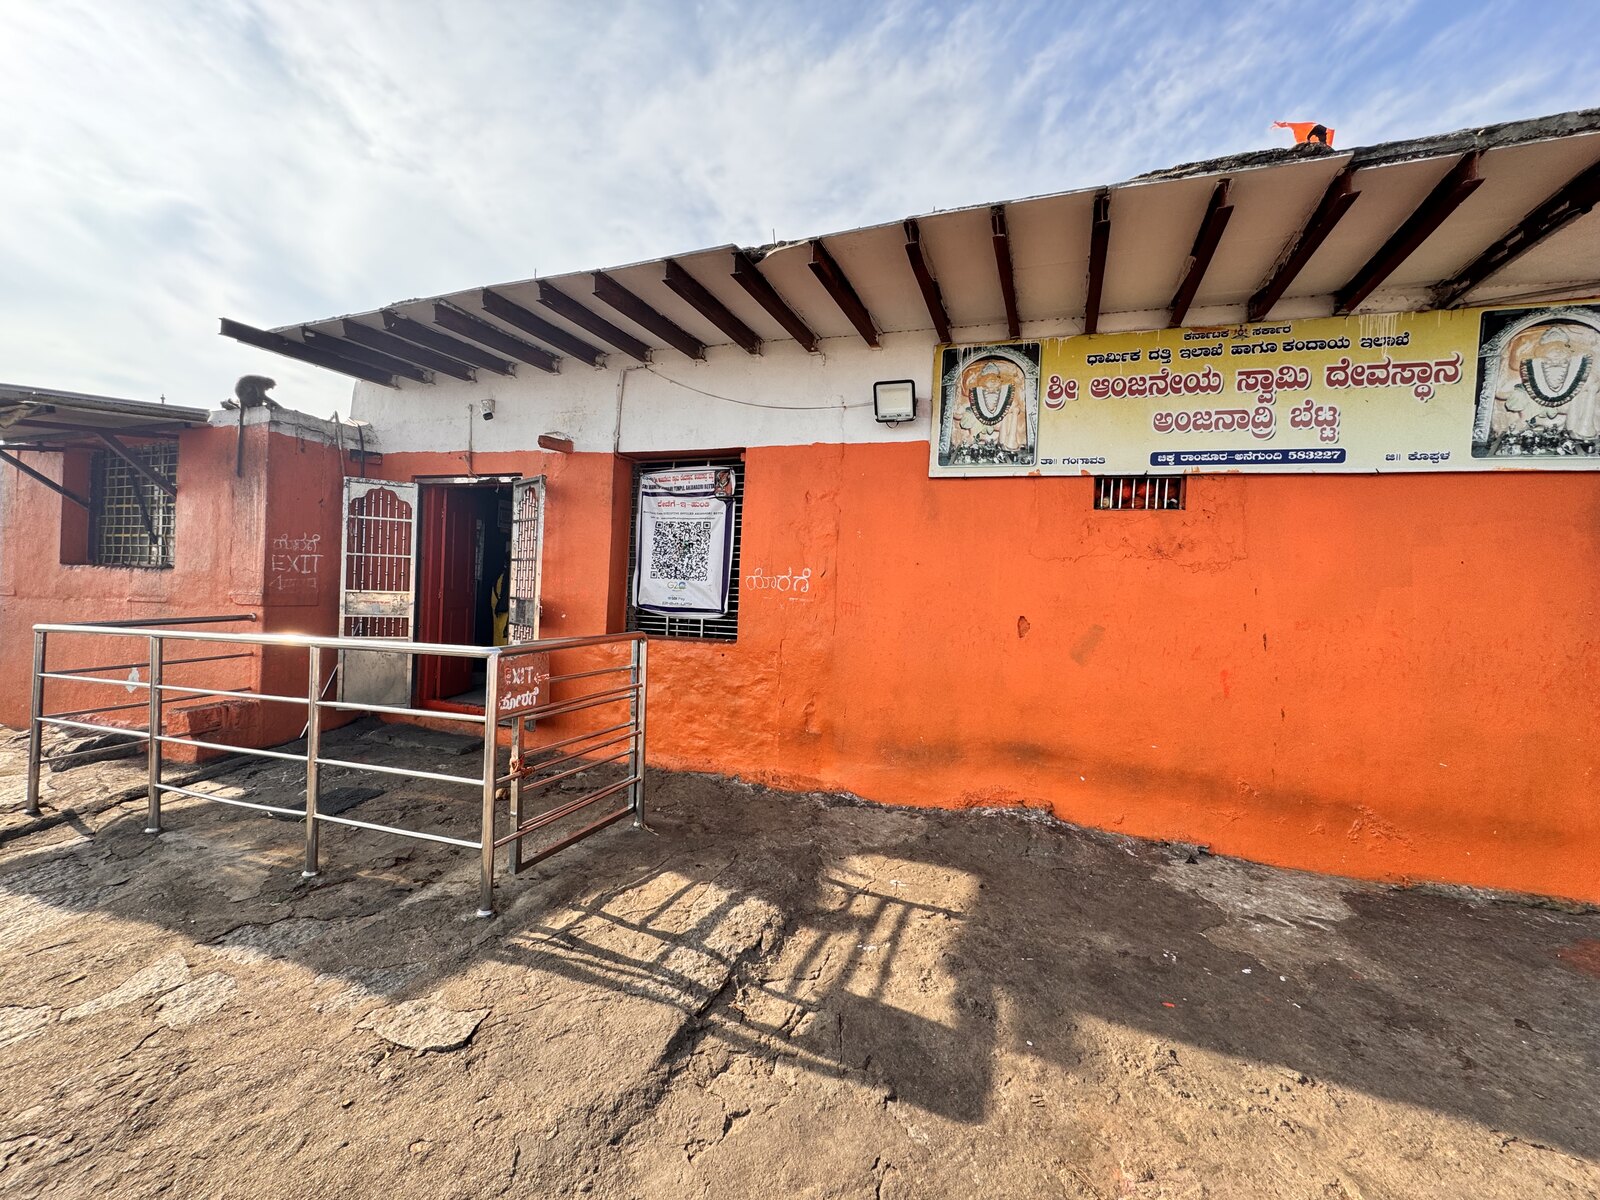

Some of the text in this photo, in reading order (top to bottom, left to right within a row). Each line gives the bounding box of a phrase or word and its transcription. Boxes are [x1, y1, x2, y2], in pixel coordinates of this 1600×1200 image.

[1184, 325, 1292, 341] ಕರ್ನಾಟಕ ಸರ್ಕಾರ
[1087, 349, 1141, 365] ಧಾರ್ಮಿಕ
[1148, 348, 1172, 364] ದತ್ತಿ
[1179, 343, 1224, 360] ಇಲಾಖೆ
[1231, 341, 1277, 355] ಹಾಗೂ
[1282, 335, 1351, 352] ಕಂದಾಯ
[1045, 351, 1463, 410] ಶ್ರೀ ಆಂಜನೇಯ ಸ್ವಾಮಿ ದೇವಸ್ಥಾನ
[1152, 398, 1342, 444] ಅಂಜನಾದ್ರಿ ಬೆಟ್ಟ
[1288, 449, 1341, 460] 583227
[1407, 451, 1450, 464] ಕೊಪ್ಪಳ
[271, 554, 324, 574] EXIT
